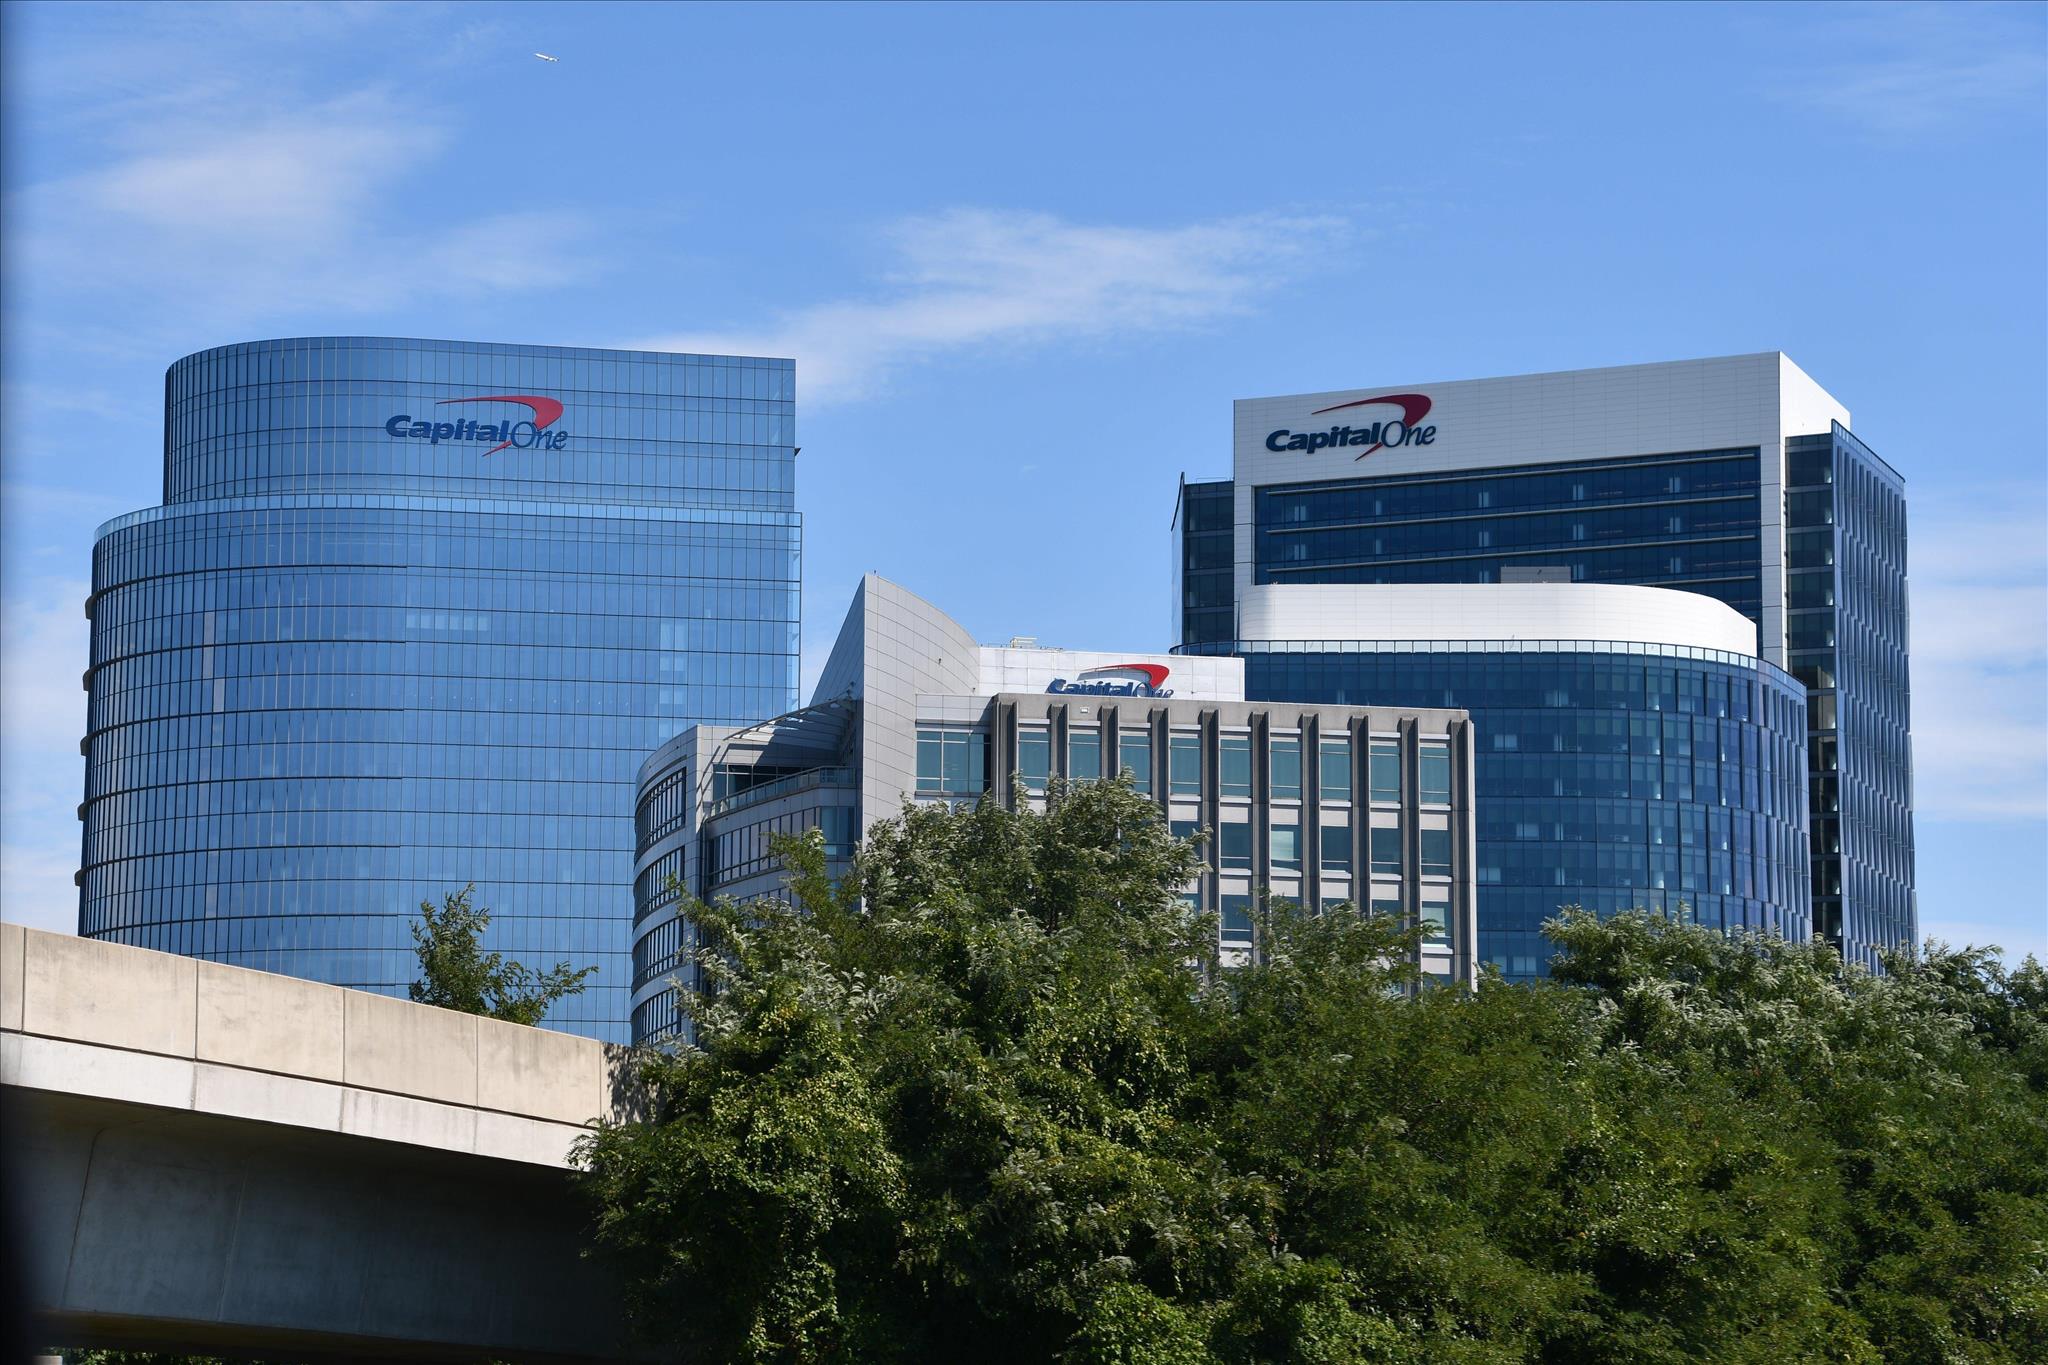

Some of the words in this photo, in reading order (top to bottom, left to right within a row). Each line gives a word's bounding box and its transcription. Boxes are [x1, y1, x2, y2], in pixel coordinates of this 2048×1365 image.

[385, 415, 510, 444] Capital
[511, 421, 569, 450] One
[1266, 422, 1382, 454] Capital
[1381, 420, 1437, 448] One
